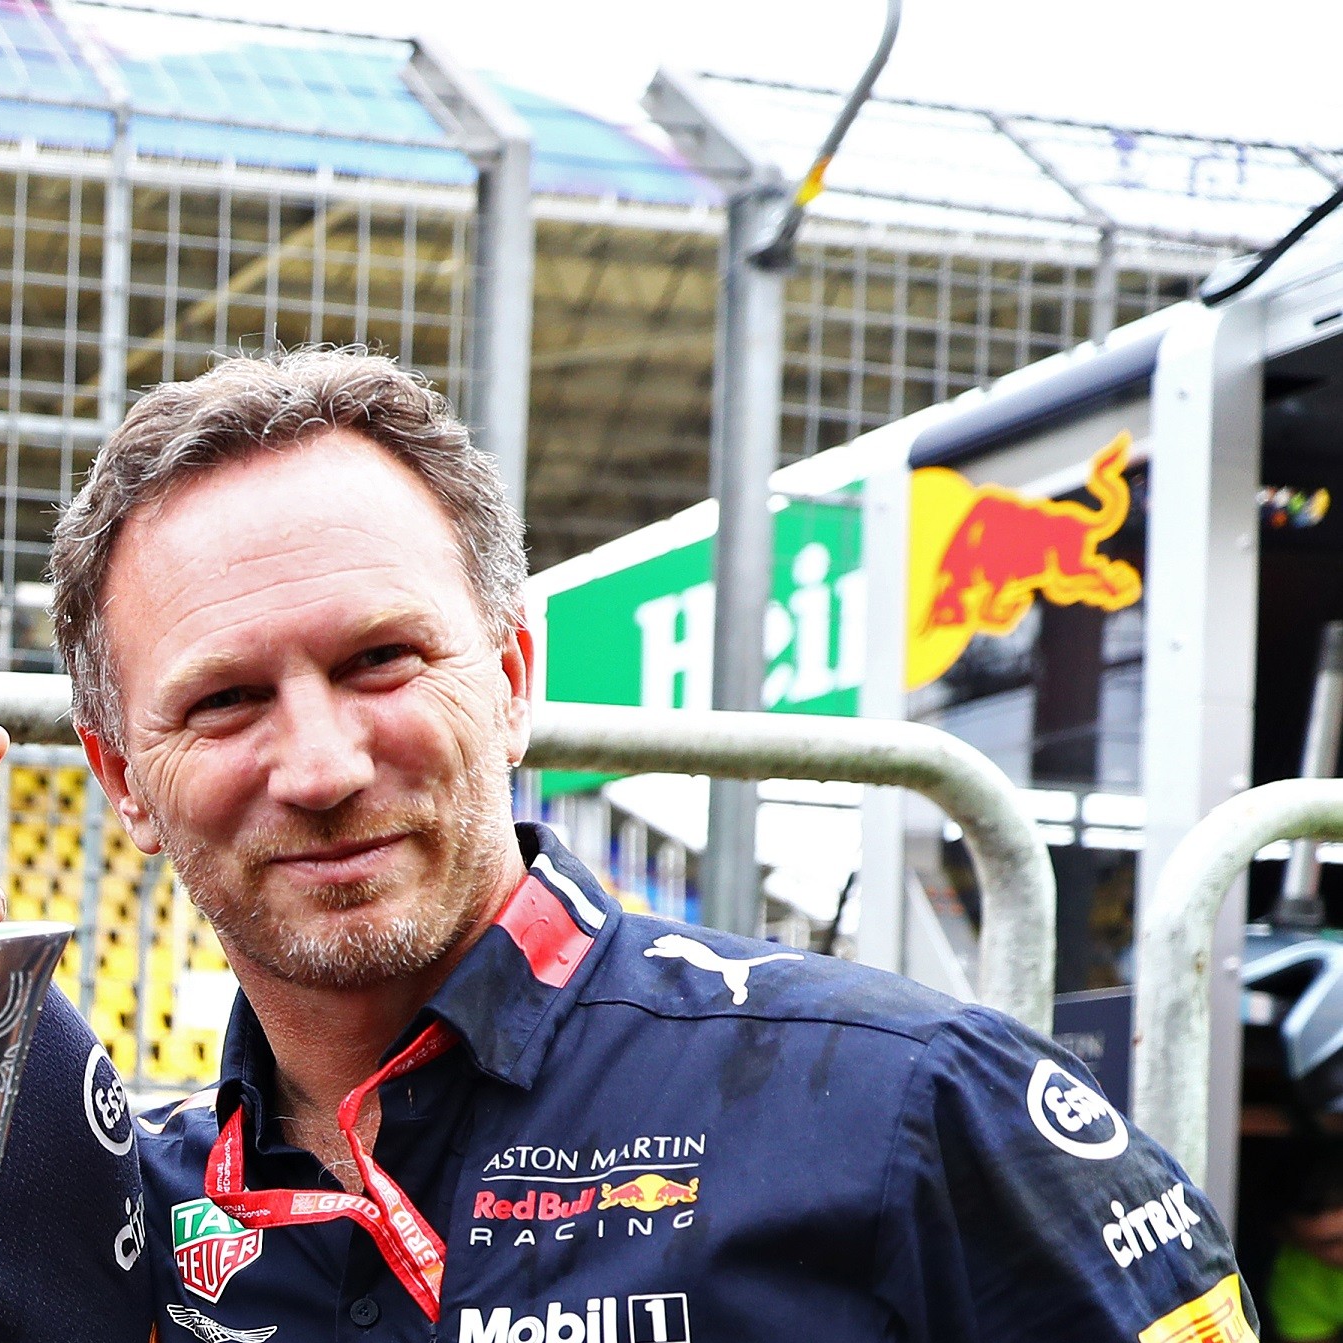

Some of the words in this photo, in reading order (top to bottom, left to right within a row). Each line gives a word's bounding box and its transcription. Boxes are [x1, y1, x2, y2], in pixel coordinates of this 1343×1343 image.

[483, 1146, 578, 1172] ASTON
[591, 1134, 706, 1170] MARTIN
[318, 1194, 381, 1220] GRID
[473, 1189, 537, 1220] Red
[537, 1187, 596, 1220] Bull
[469, 1210, 695, 1247] RACING
[176, 1234, 256, 1292] HEUER
